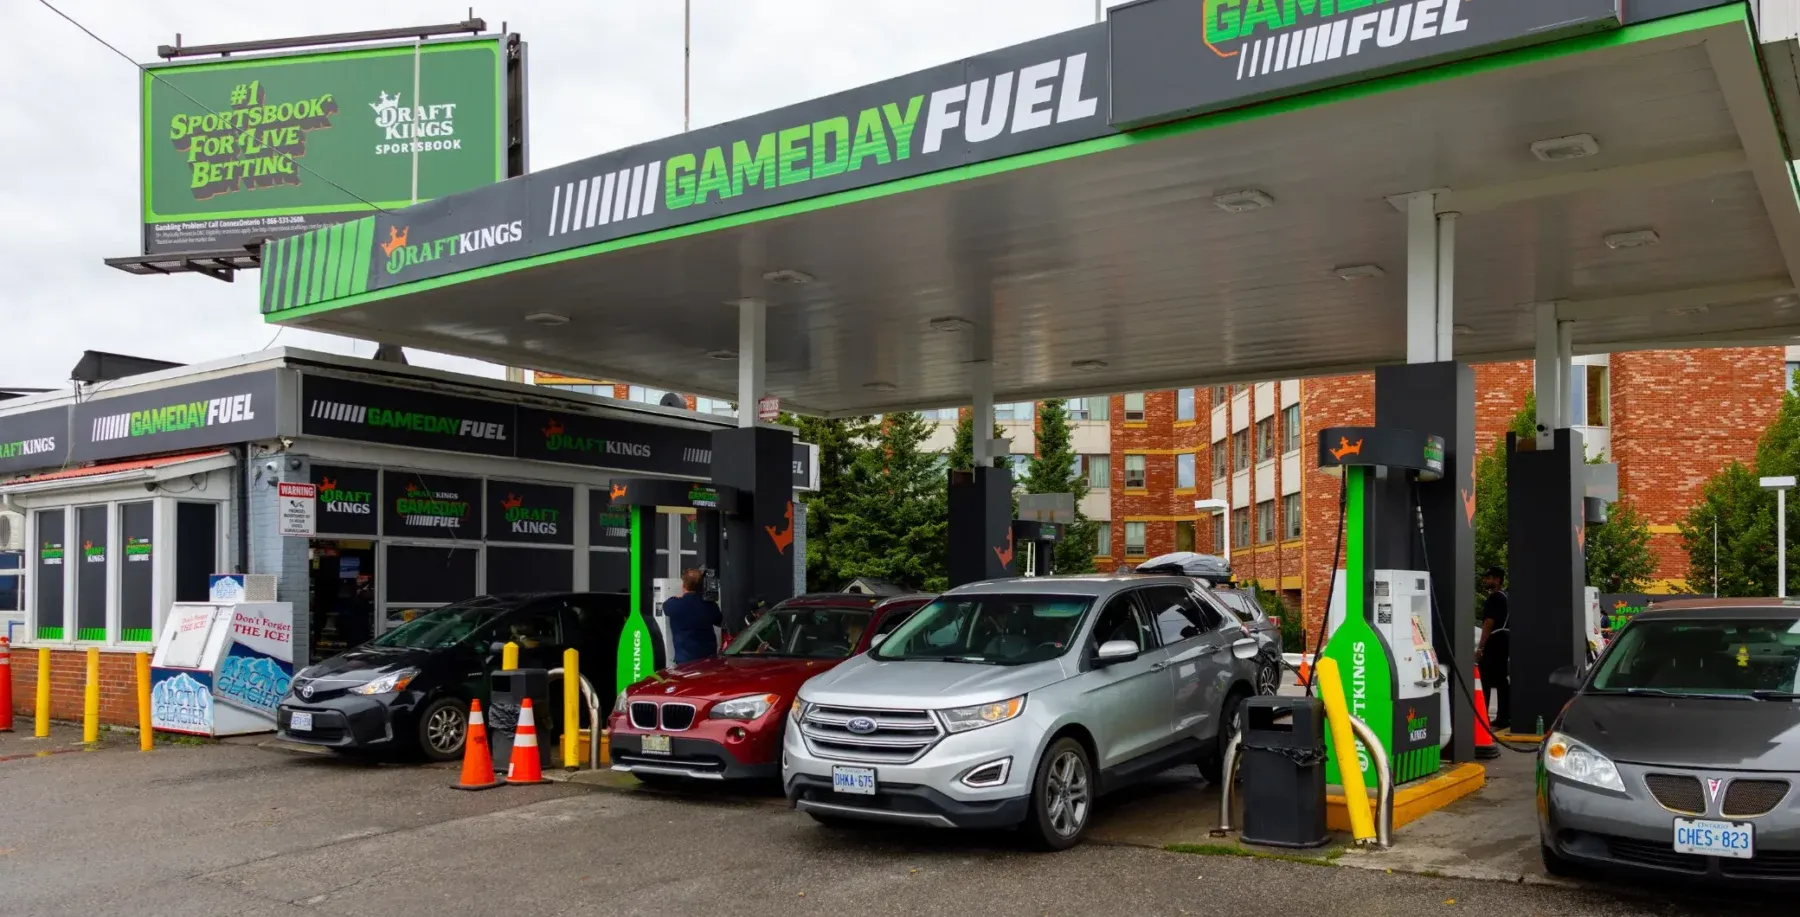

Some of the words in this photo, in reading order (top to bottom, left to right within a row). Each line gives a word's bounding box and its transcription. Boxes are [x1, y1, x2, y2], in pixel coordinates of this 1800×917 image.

[1347, 0, 1469, 56] FUEL
[231, 80, 259, 106] #1
[170, 94, 333, 139] SPORTSBOOK
[375, 103, 456, 127] DRAFT
[385, 120, 454, 140] KINGS
[375, 139, 462, 155] SPORTSBOOK
[191, 154, 294, 188] BETTING
[386, 220, 522, 274] DRAFTKINGS
[546, 433, 651, 458] DRAFTKINGS
[281, 485, 314, 497] WARNING
[320, 488, 373, 503] DRAFT
[326, 500, 370, 514] KINGS
[397, 498, 467, 517] GAMEDAY
[505, 506, 559, 522] DRAFT
[433, 516, 461, 528] FUEL
[512, 519, 557, 535] KINGS
[235, 613, 260, 625] Don't
[262, 618, 291, 632] Forget
[233, 623, 261, 637] THE
[264, 629, 290, 643] ICE!
[221, 659, 290, 696] ARCTIC
[157, 682, 208, 709] ARCTIC
[218, 676, 280, 709] GLACIER
[157, 705, 208, 726] GLACIER
[853, 719, 870, 730] Ford
[1410, 728, 1427, 742] KINGS
[858, 775, 873, 788] 675
[1678, 828, 1713, 847] CHES
[1722, 831, 1749, 849] 823
